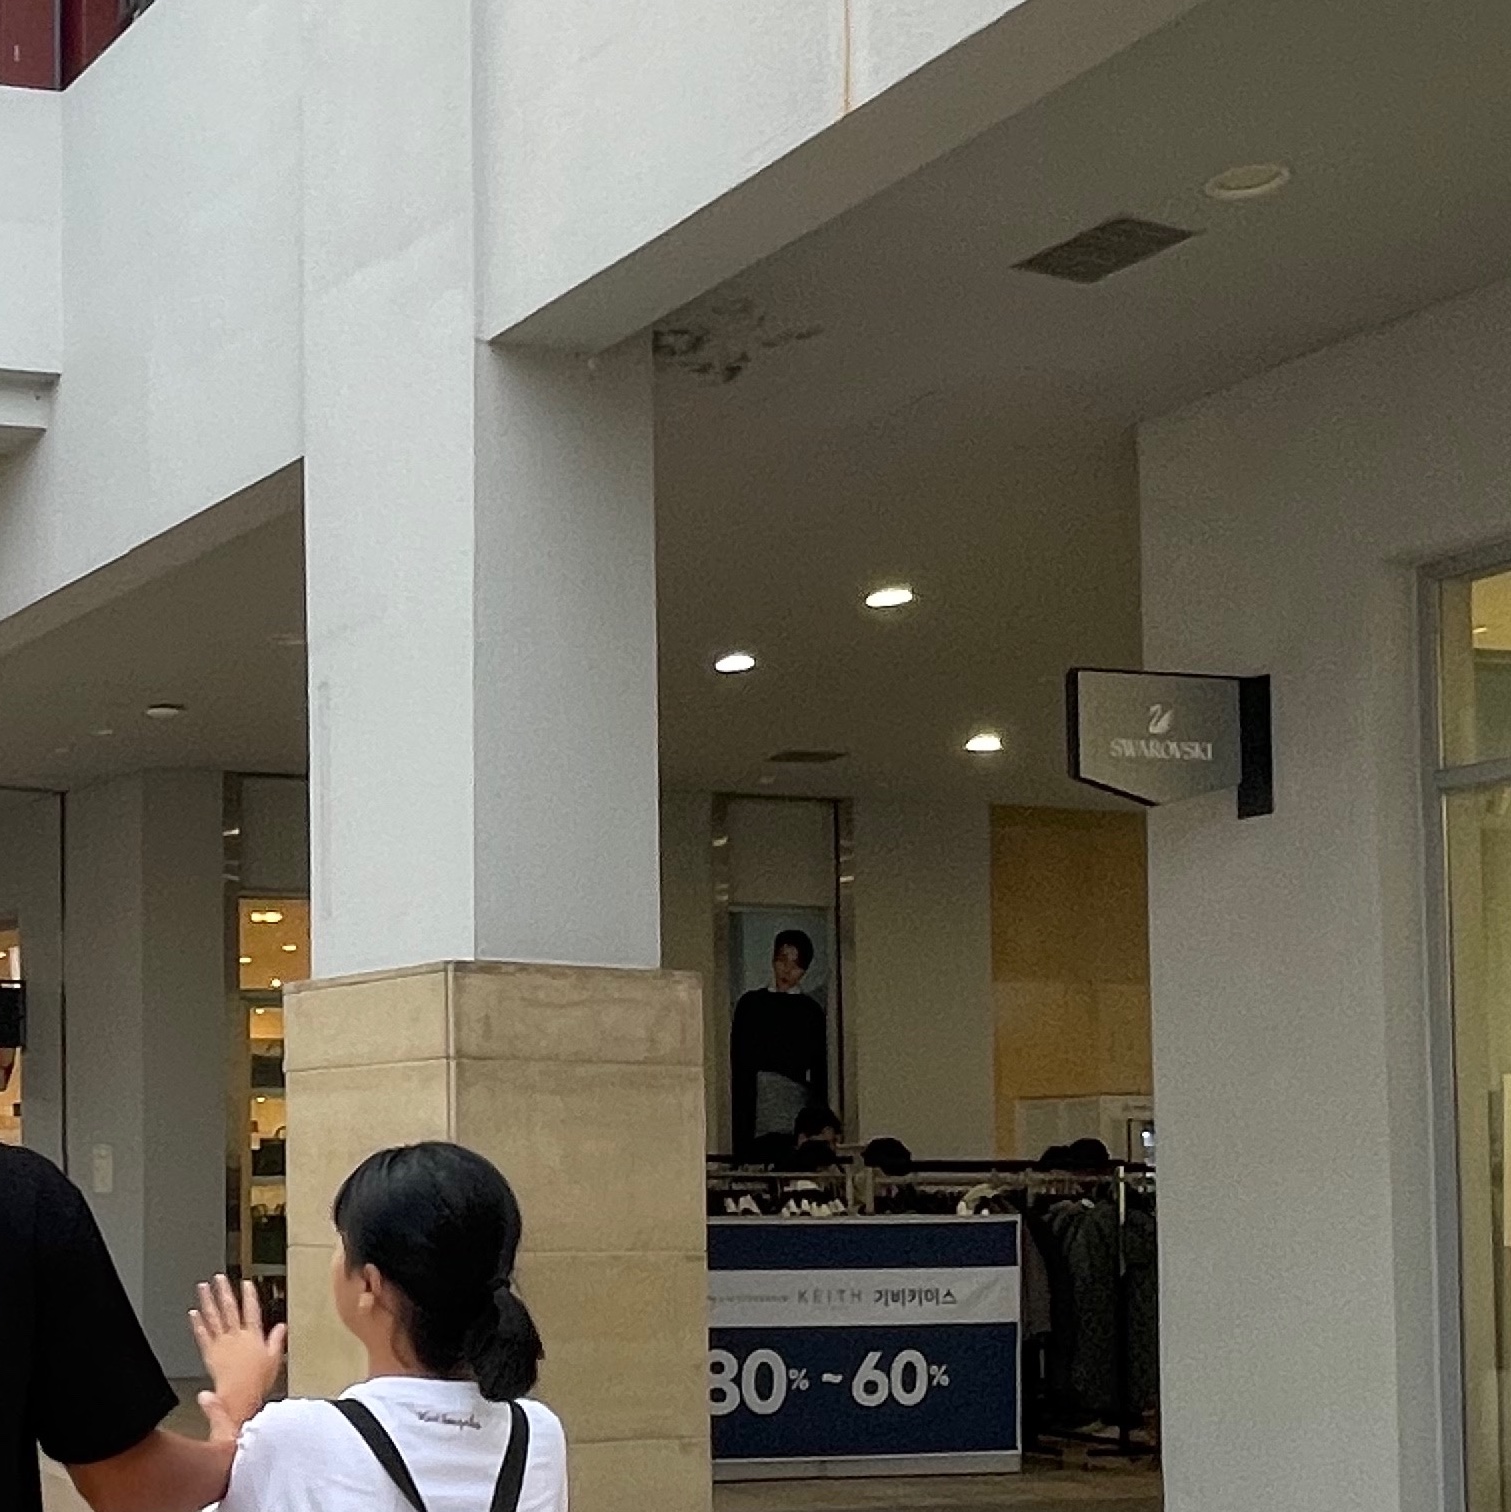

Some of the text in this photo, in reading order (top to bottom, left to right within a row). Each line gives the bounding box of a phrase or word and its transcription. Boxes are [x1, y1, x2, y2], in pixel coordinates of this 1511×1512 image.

[1109, 738, 1213, 761] SWAROVSKI
[797, 1288, 863, 1304] KEITH
[851, 1349, 951, 1407] 60%
